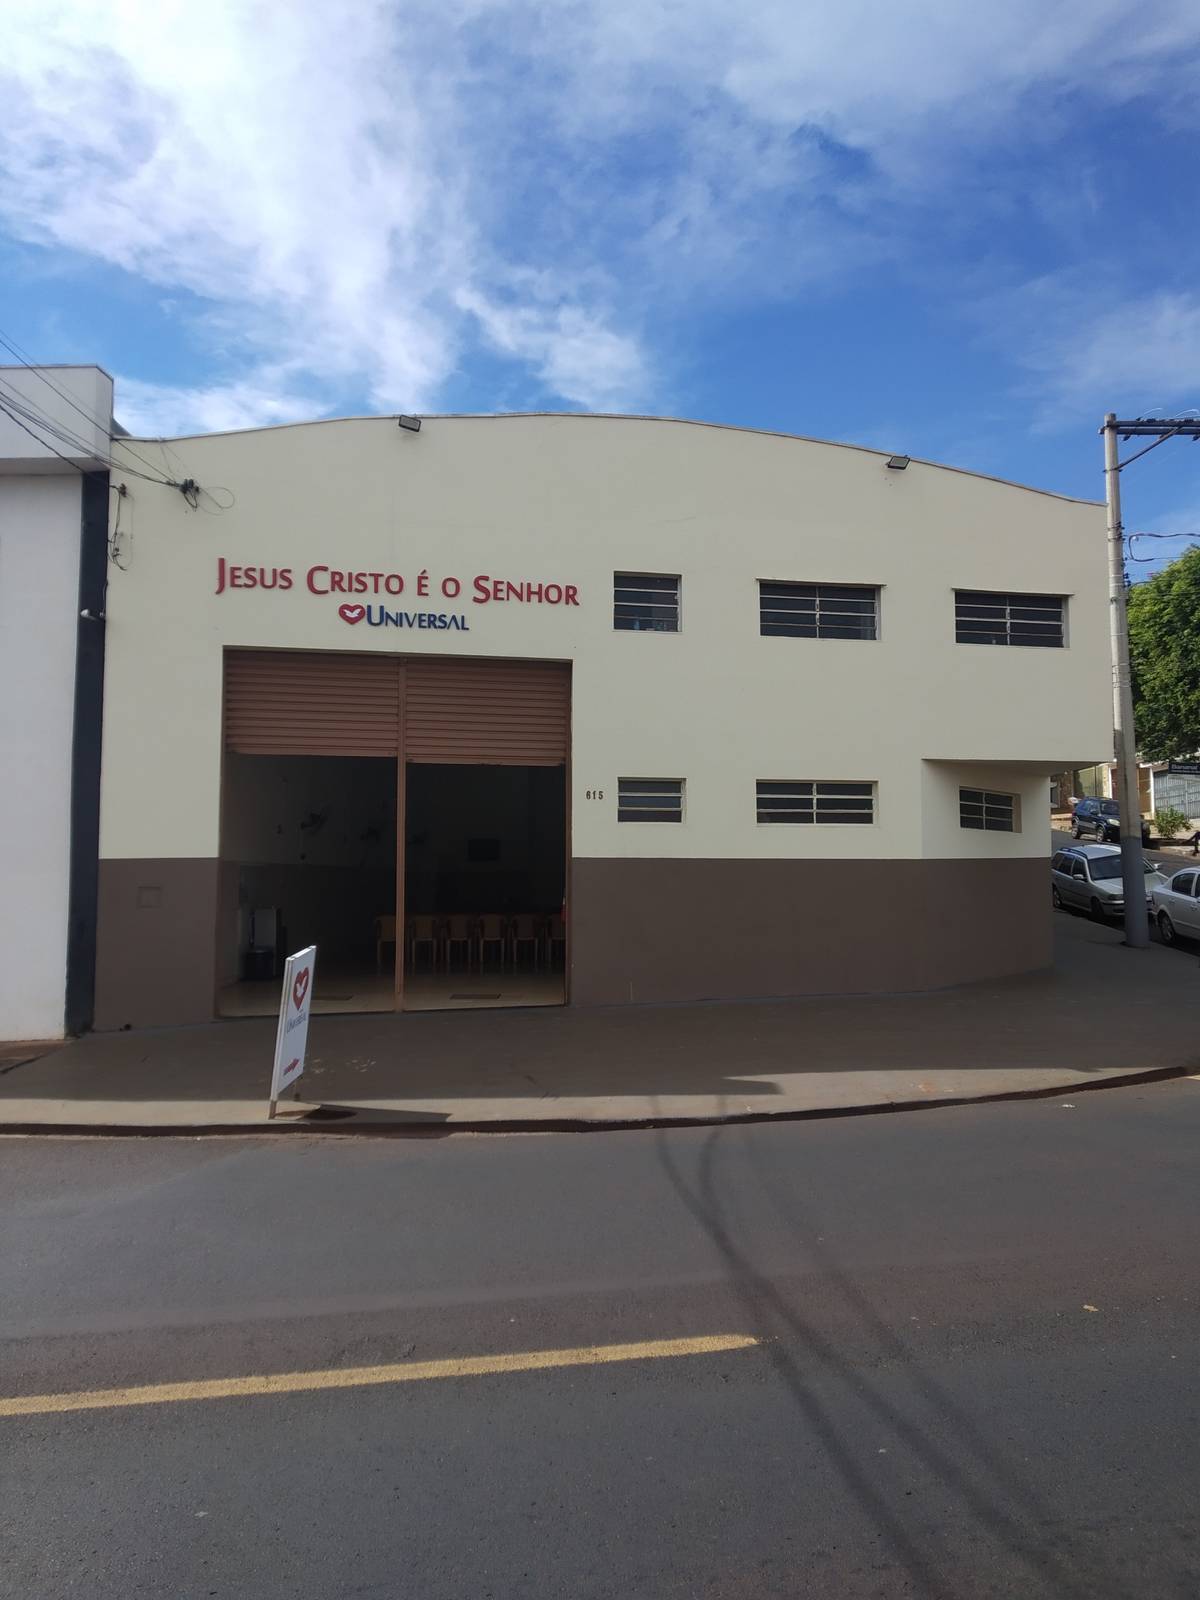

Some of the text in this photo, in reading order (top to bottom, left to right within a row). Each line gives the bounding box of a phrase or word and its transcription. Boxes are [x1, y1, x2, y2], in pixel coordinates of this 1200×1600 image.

[214, 557, 580, 606] JESUS CRISTO É O SENHOR
[366, 604, 469, 631] UNIVERSAL
[585, 790, 604, 800] 615
